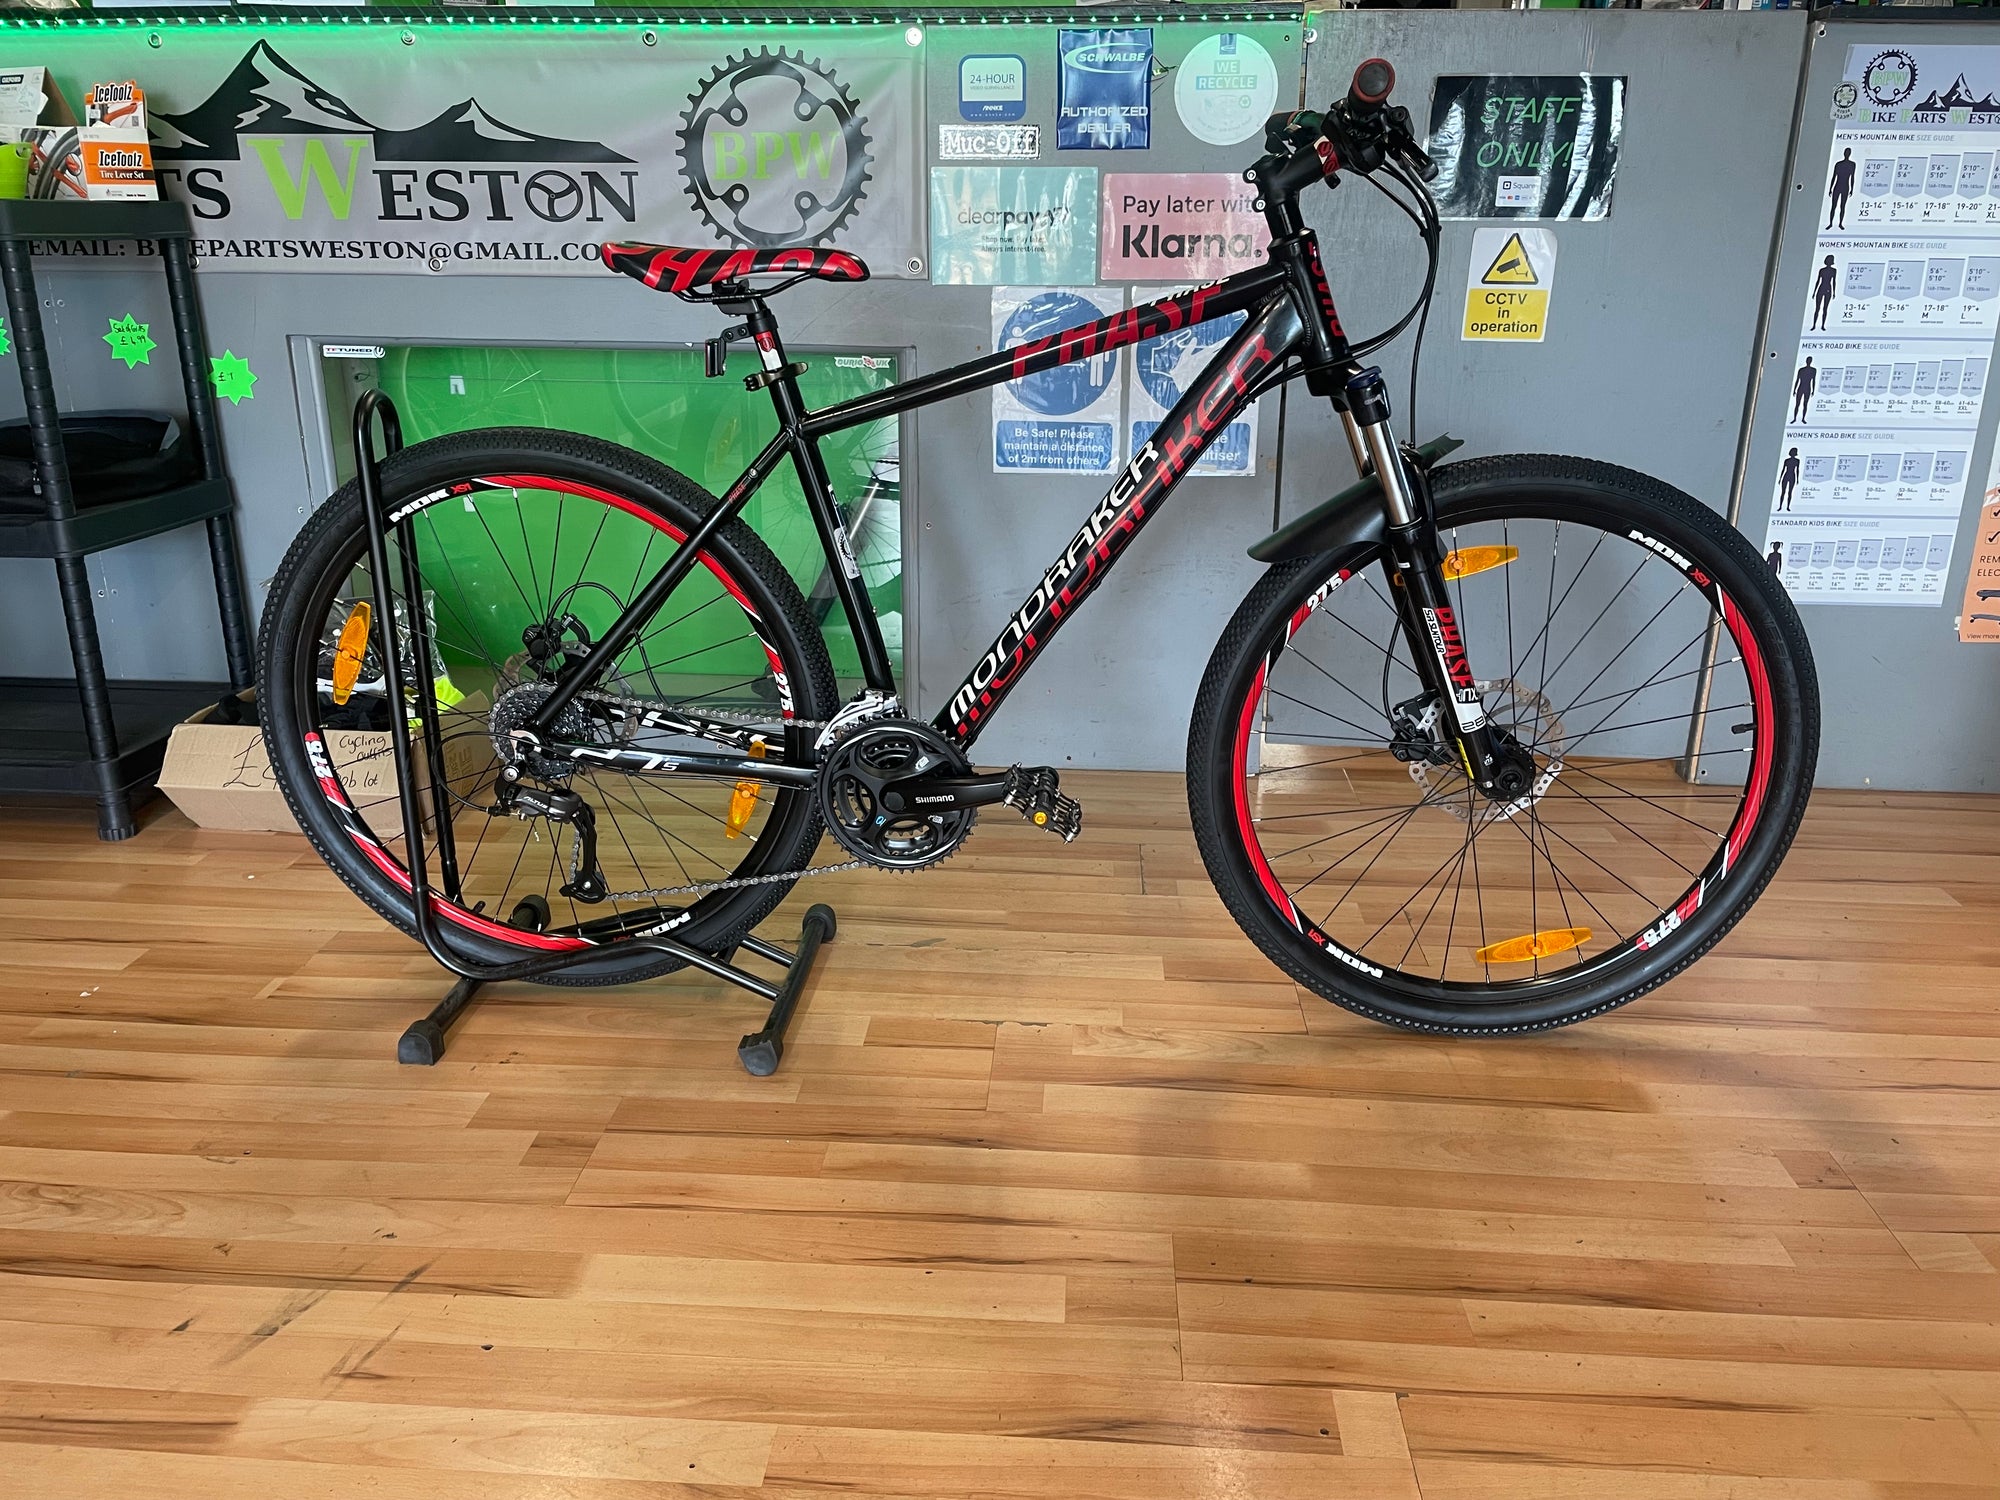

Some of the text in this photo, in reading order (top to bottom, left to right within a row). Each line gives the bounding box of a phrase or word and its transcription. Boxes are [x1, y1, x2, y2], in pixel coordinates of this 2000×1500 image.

[1078, 52, 1145, 63] SCHWALBE
[1216, 61, 1237, 72] WE
[970, 74, 1015, 83] 24-HOUR
[1199, 77, 1254, 88] RECYCLE
[1871, 70, 1909, 86] BPW
[95, 84, 132, 102] IceToolz
[1480, 97, 1582, 124] STAFF
[1858, 108, 1896, 123] BIKE
[1901, 108, 1947, 123] PARTS
[1077, 122, 1131, 134] DEALER
[945, 131, 1037, 155] Muc-Off
[1836, 133, 1859, 141] MEN'S
[1898, 134, 1915, 142] BIKE
[1916, 134, 1932, 142] SIZE
[99, 151, 142, 167] IceToolz
[711, 130, 838, 181] BPW
[1476, 142, 1575, 168] ONLY!
[134, 171, 144, 179] Set
[246, 139, 639, 222] WESTON
[1123, 195, 1253, 217] Pay later wit
[958, 207, 1040, 231] clearpay
[1122, 224, 1264, 258] Klarna.
[28, 240, 600, 262] EMAIL: BIEPARTSWESTON@GMAIL.CO
[1485, 293, 1528, 305] CCTV
[1498, 307, 1510, 318] in
[1471, 321, 1538, 335] operation
[1015, 428, 1095, 439] Be Safe! Please
[1004, 442, 1048, 451] maintain
[1060, 443, 1104, 452] distance
[1008, 455, 1099, 466] of 2m from others
[949, 440, 1160, 725] MONDRAKER
[339, 735, 386, 754] Cycling
[364, 771, 378, 788] lot
[915, 794, 955, 804] SHIMANO
